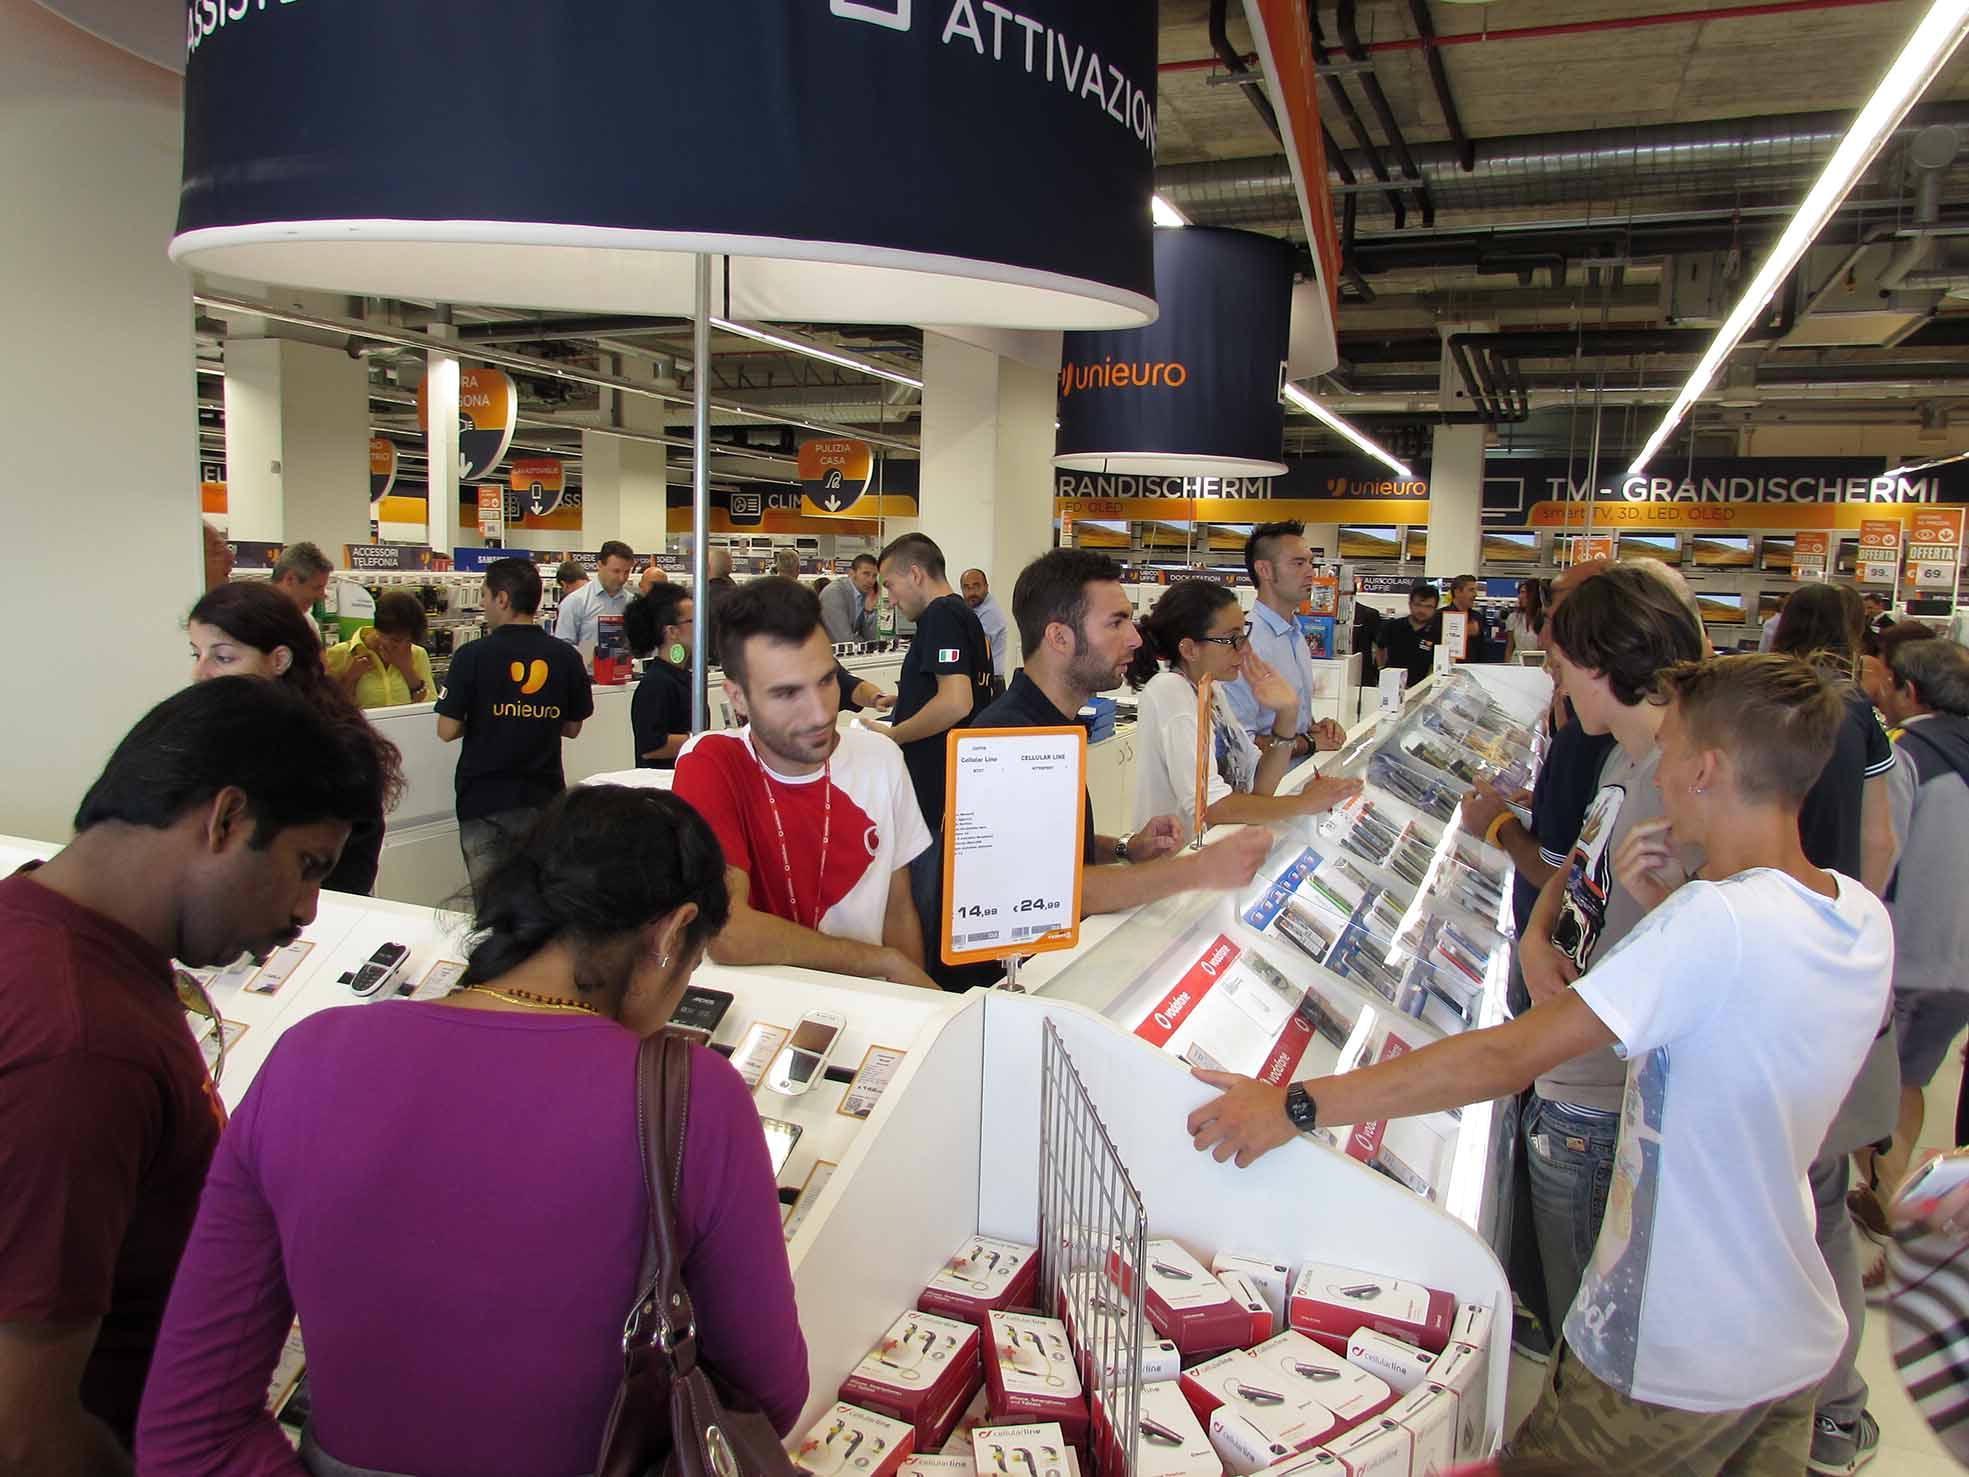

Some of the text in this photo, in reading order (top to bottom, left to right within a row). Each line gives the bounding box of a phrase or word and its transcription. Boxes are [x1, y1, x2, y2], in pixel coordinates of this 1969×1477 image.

[1076, 356, 1187, 389] unieuro
[815, 444, 850, 452] PULIZIA
[820, 456, 846, 465] CASA
[1054, 476, 1272, 499] RANDISCHERMI
[1351, 478, 1426, 496] unieuro
[1546, 478, 1586, 502] TV
[1622, 477, 1939, 503] GRANDISCHERMI
[1088, 501, 1123, 513] OLED
[1688, 508, 1735, 521] OLED
[352, 548, 399, 557] ACCESSORI
[1910, 547, 1953, 560] OFFERTA
[352, 557, 399, 567] TELEFONIA
[493, 700, 561, 719] unieuro
[1020, 898, 1061, 912] 24,99
[1163, 990, 1192, 1020] vodafone
[1268, 1051, 1291, 1083] vodafone
[1364, 1352, 1408, 1376] cellularline
